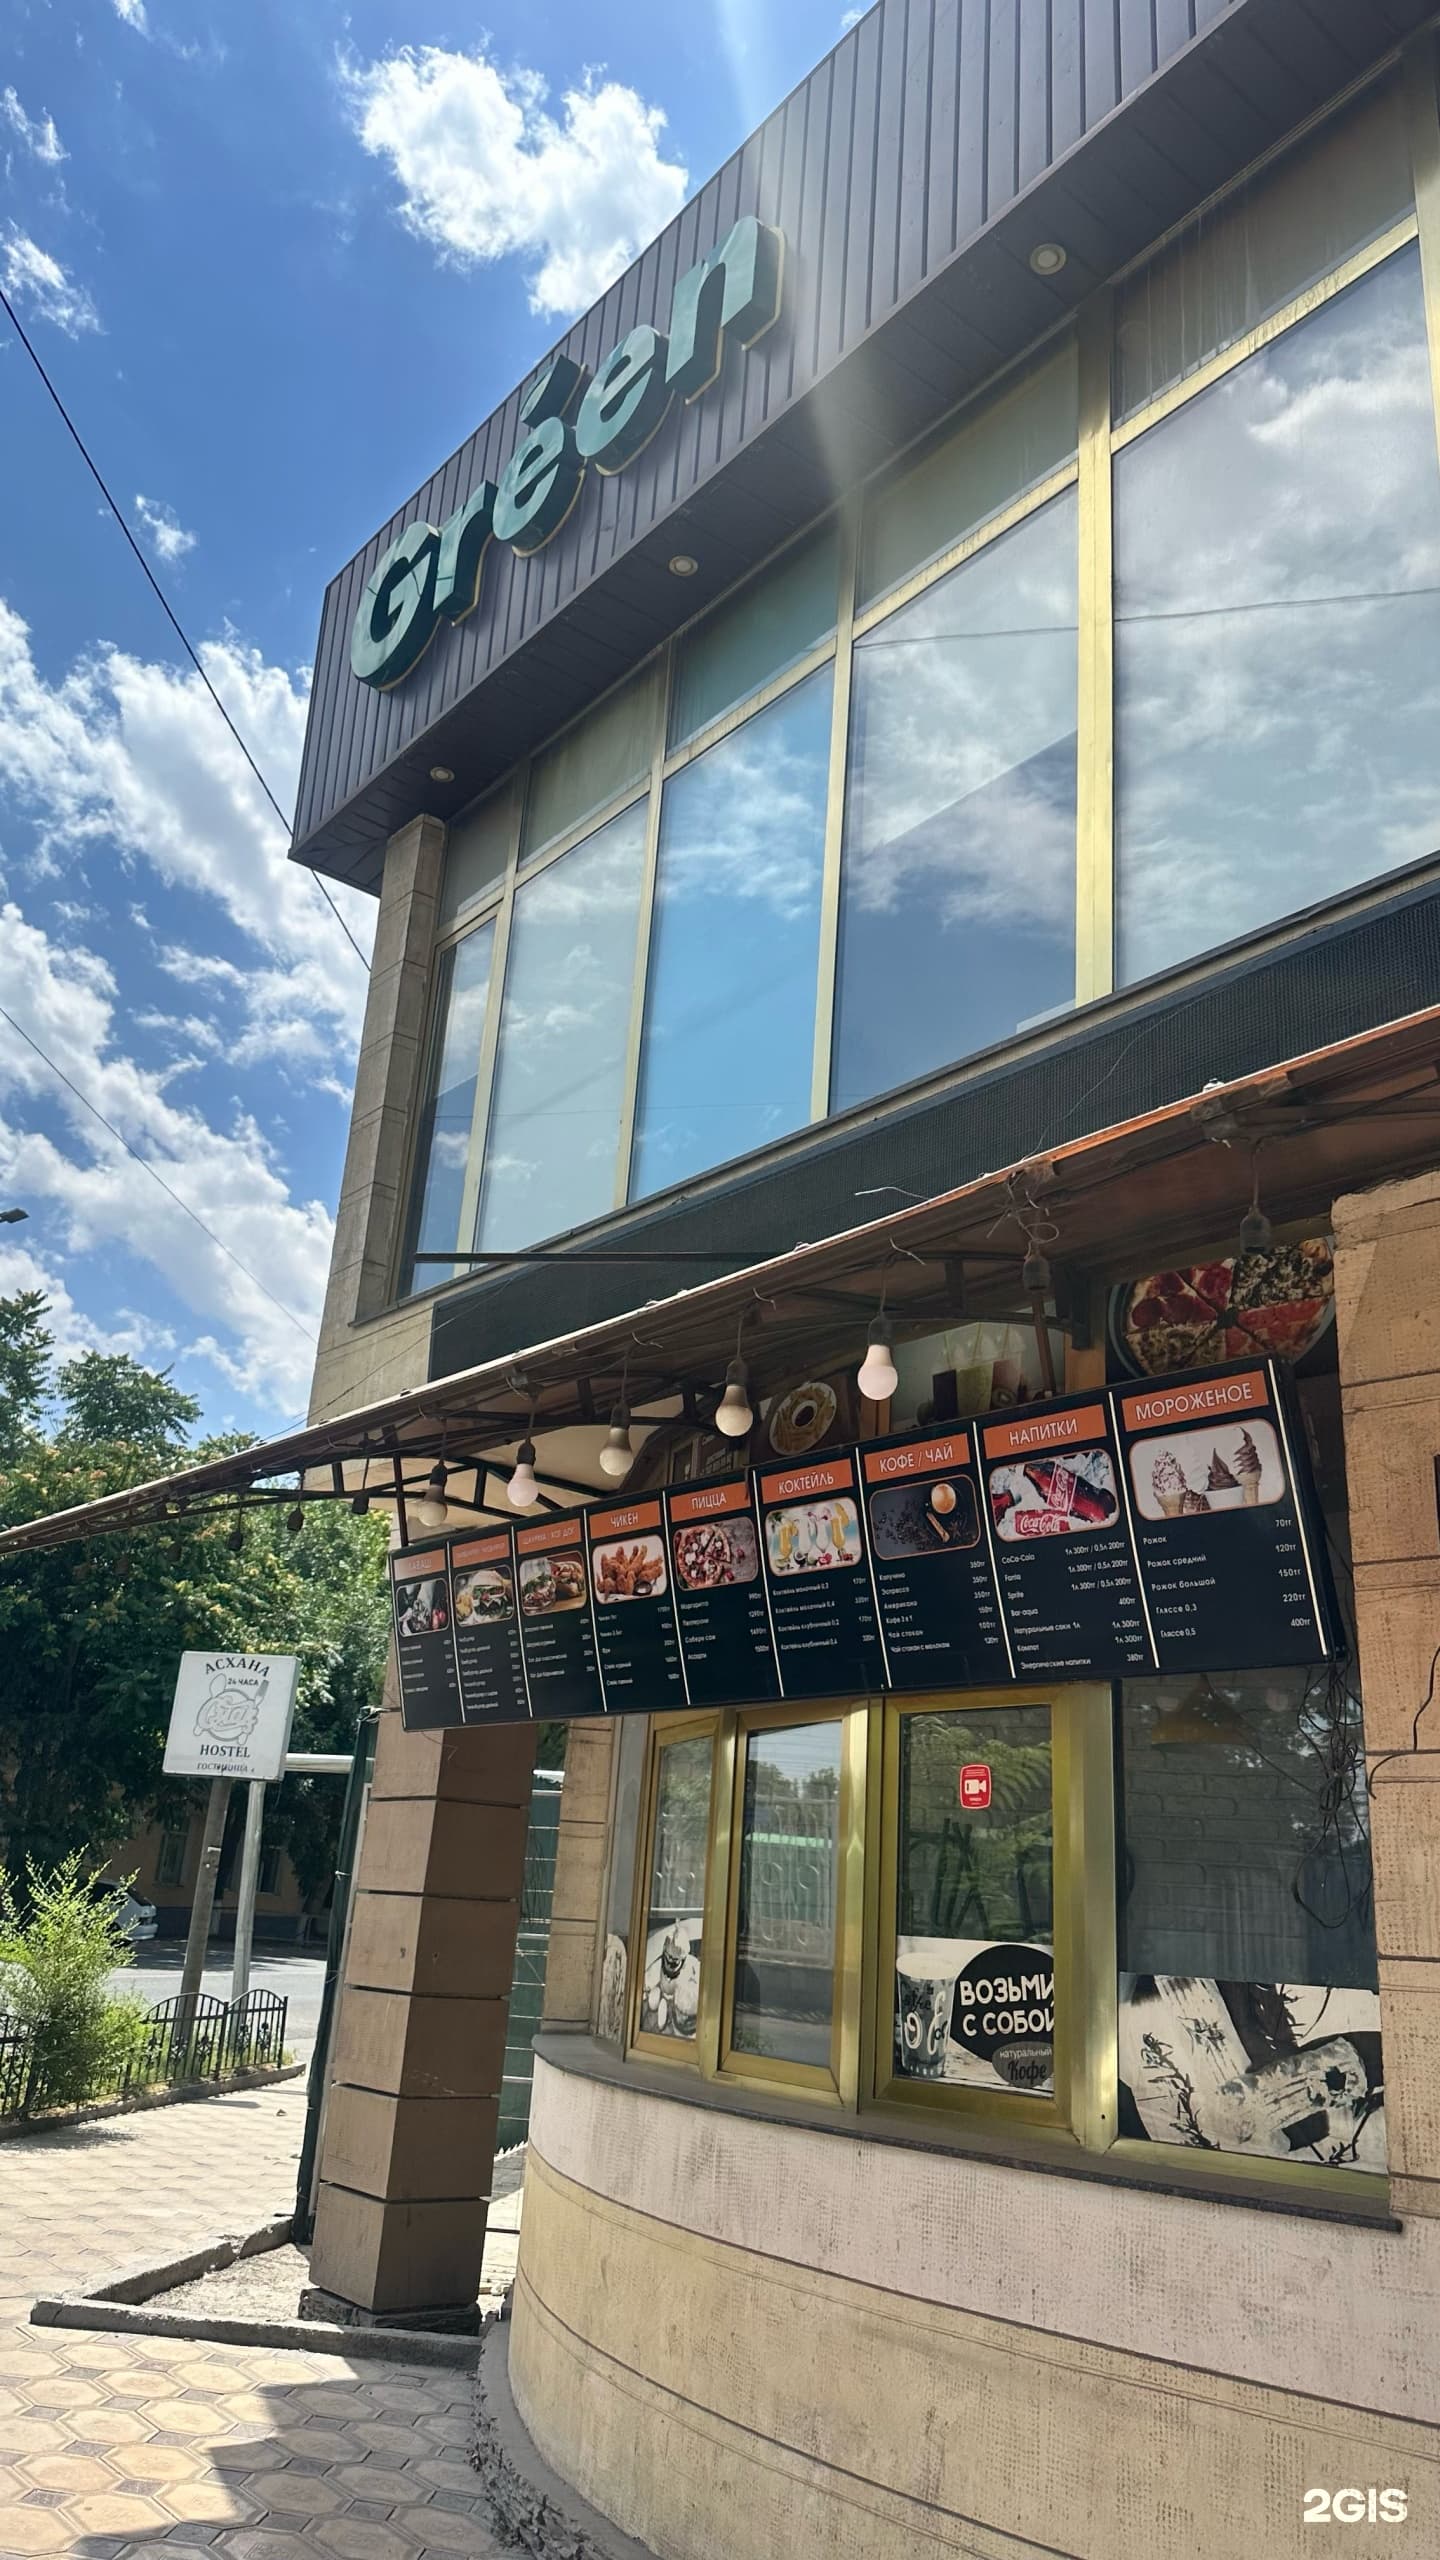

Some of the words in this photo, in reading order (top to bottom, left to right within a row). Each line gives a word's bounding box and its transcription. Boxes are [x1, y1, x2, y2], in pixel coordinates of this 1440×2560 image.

[1135, 1383, 1253, 1421] МОРОЖЕНОЕ
[1009, 1418, 1078, 1446] НАПИТКИ
[880, 1453, 914, 1473] КОФЕ
[925, 1442, 953, 1462] ЧАЙ
[778, 1472, 834, 1495] КОКТЕЙЛЬ
[692, 1492, 727, 1510] ПИЦЦА
[610, 1512, 638, 1528] ЧИКЕН
[1143, 1536, 1167, 1545] Рожок
[1147, 1559, 1171, 1568] Рожок
[1172, 1554, 1207, 1566] средний
[1151, 1582, 1177, 1592] Рожок
[1179, 1577, 1215, 1589] большой
[205, 1657, 270, 1677] АСХАНА
[200, 1744, 251, 1758] HOSTEL
[960, 1973, 1053, 2006] ВОЗЬМИ
[963, 2013, 977, 2036] С
[1000, 2048, 1053, 2060] натуральный
[1008, 2059, 1048, 2084] Кофе
